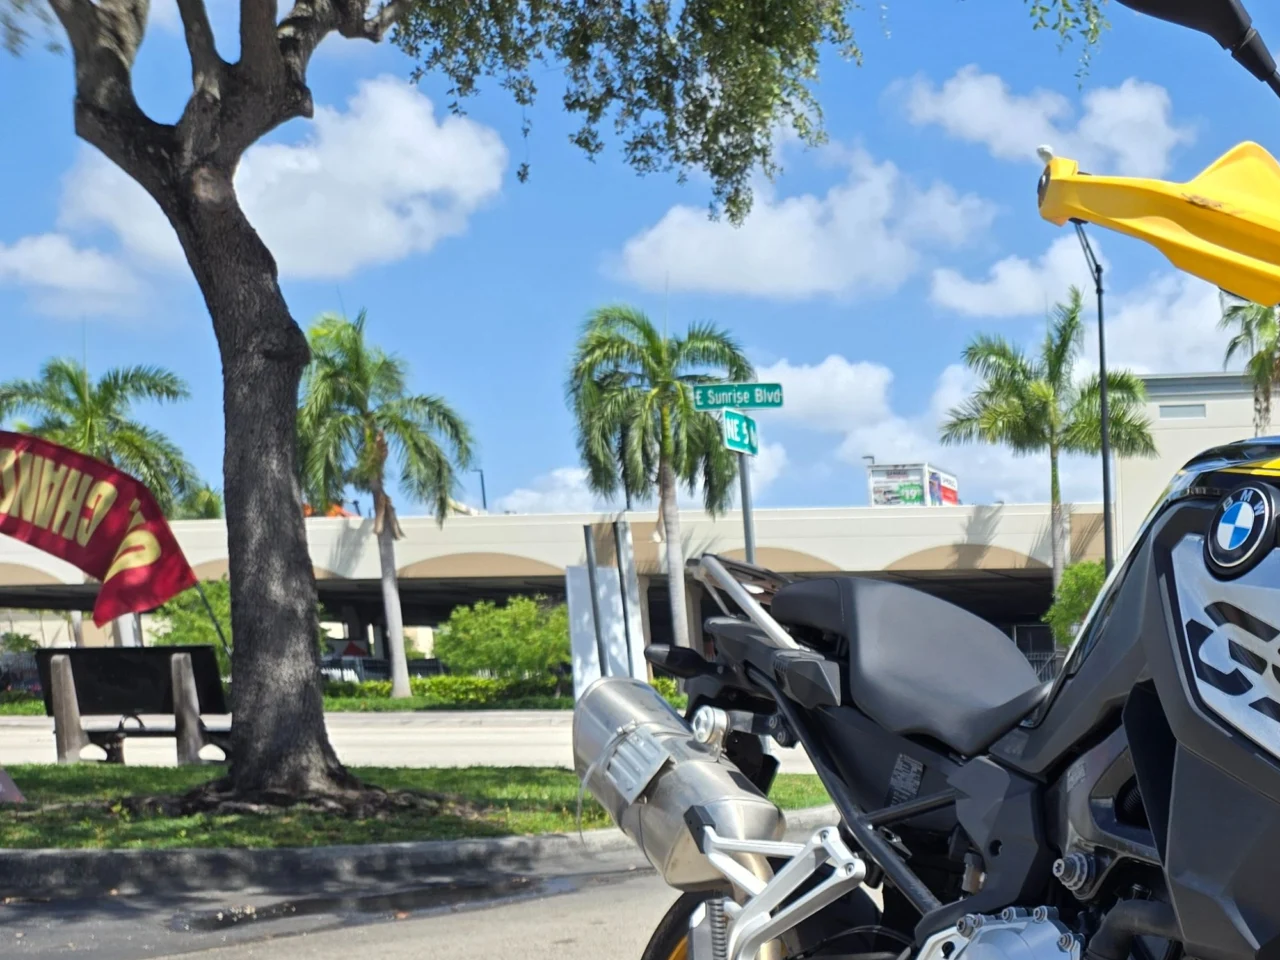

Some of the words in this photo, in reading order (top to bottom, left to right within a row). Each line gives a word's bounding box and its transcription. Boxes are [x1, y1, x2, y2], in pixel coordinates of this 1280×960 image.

[696, 389, 704, 406] E
[707, 388, 750, 405] Sunrise
[754, 387, 782, 404] Blvd
[726, 417, 741, 442] NE
[1222, 488, 1265, 517] BMW
